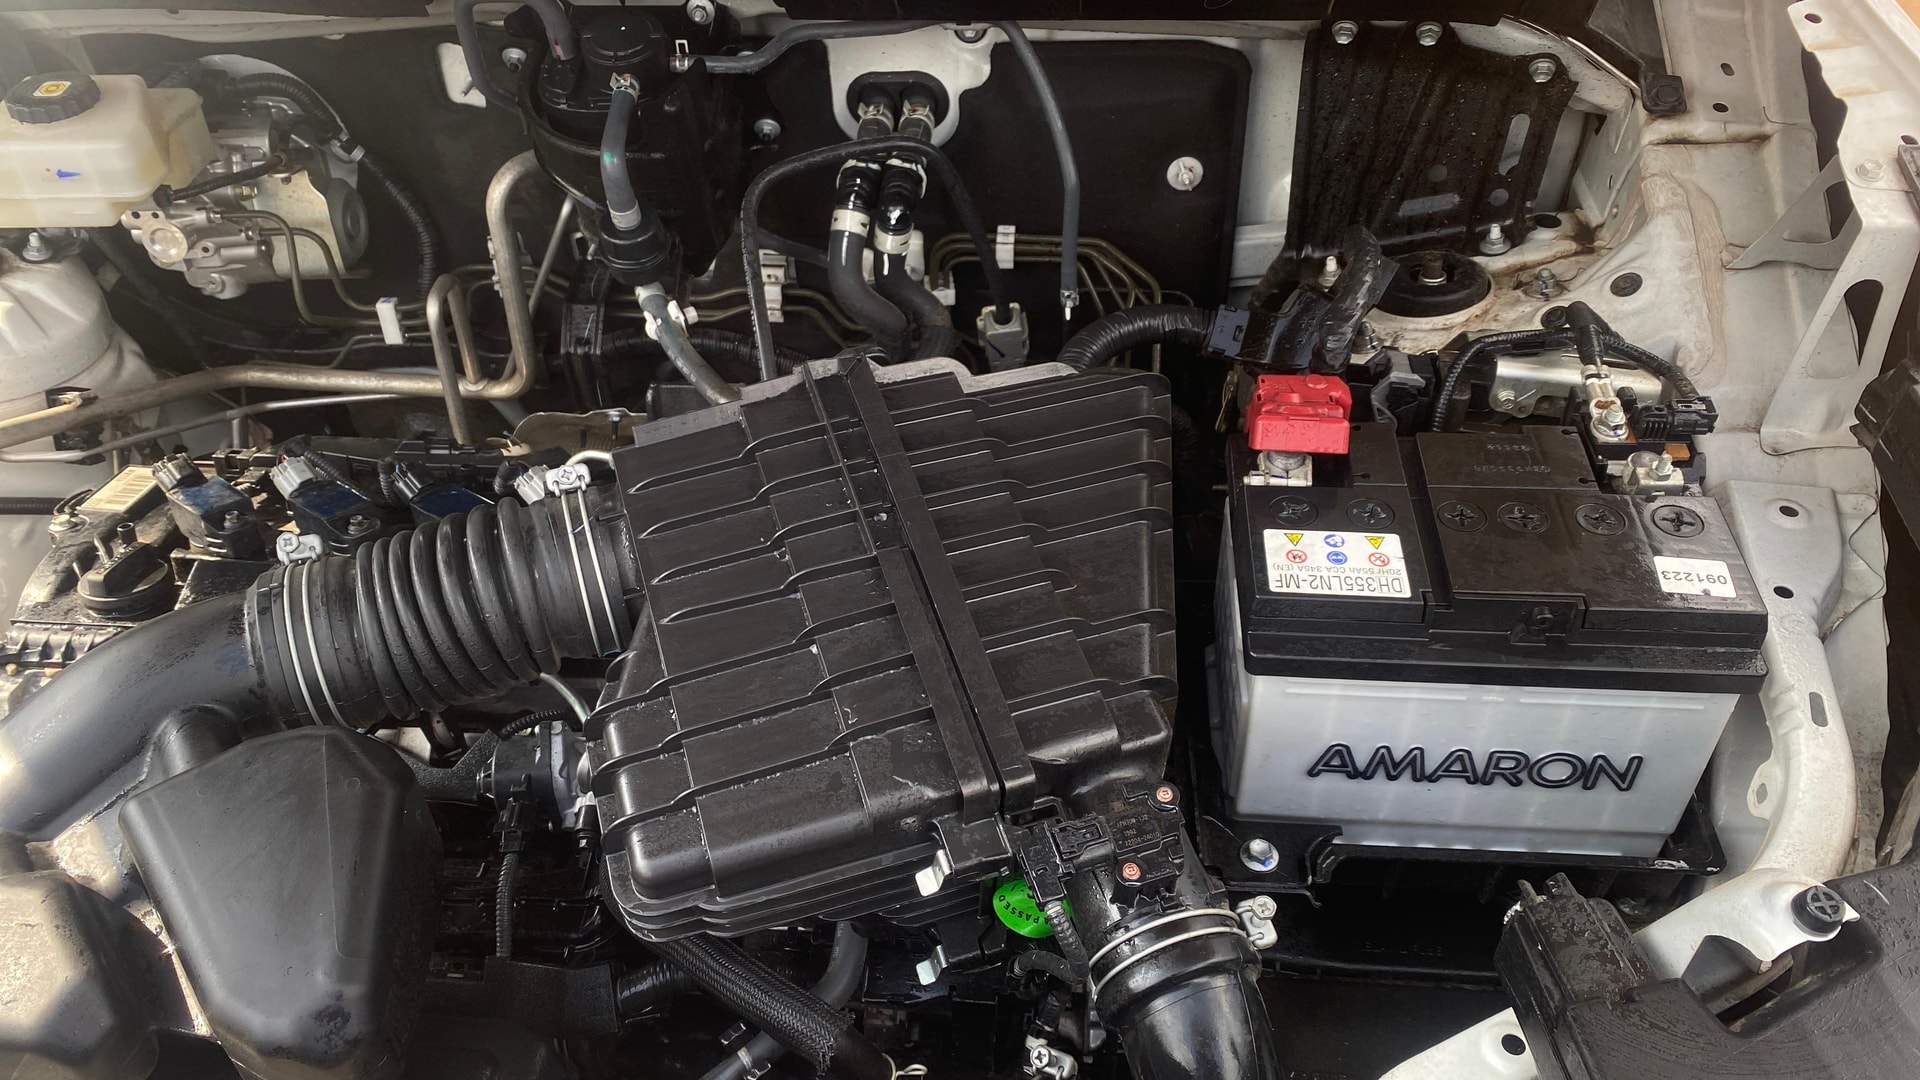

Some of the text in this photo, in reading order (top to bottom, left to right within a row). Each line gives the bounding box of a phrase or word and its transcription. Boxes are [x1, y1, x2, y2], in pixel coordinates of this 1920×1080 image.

[1272, 563, 1295, 572] (EN)
[1298, 565, 1321, 573] 345A
[1324, 566, 1346, 574] CCA
[1348, 567, 1375, 575] 55Ah
[1275, 573, 1404, 593] DH355LN2-MF
[1661, 570, 1728, 585] 091223
[1307, 742, 1644, 791] AMARON
[998, 894, 1040, 924] PASSED
